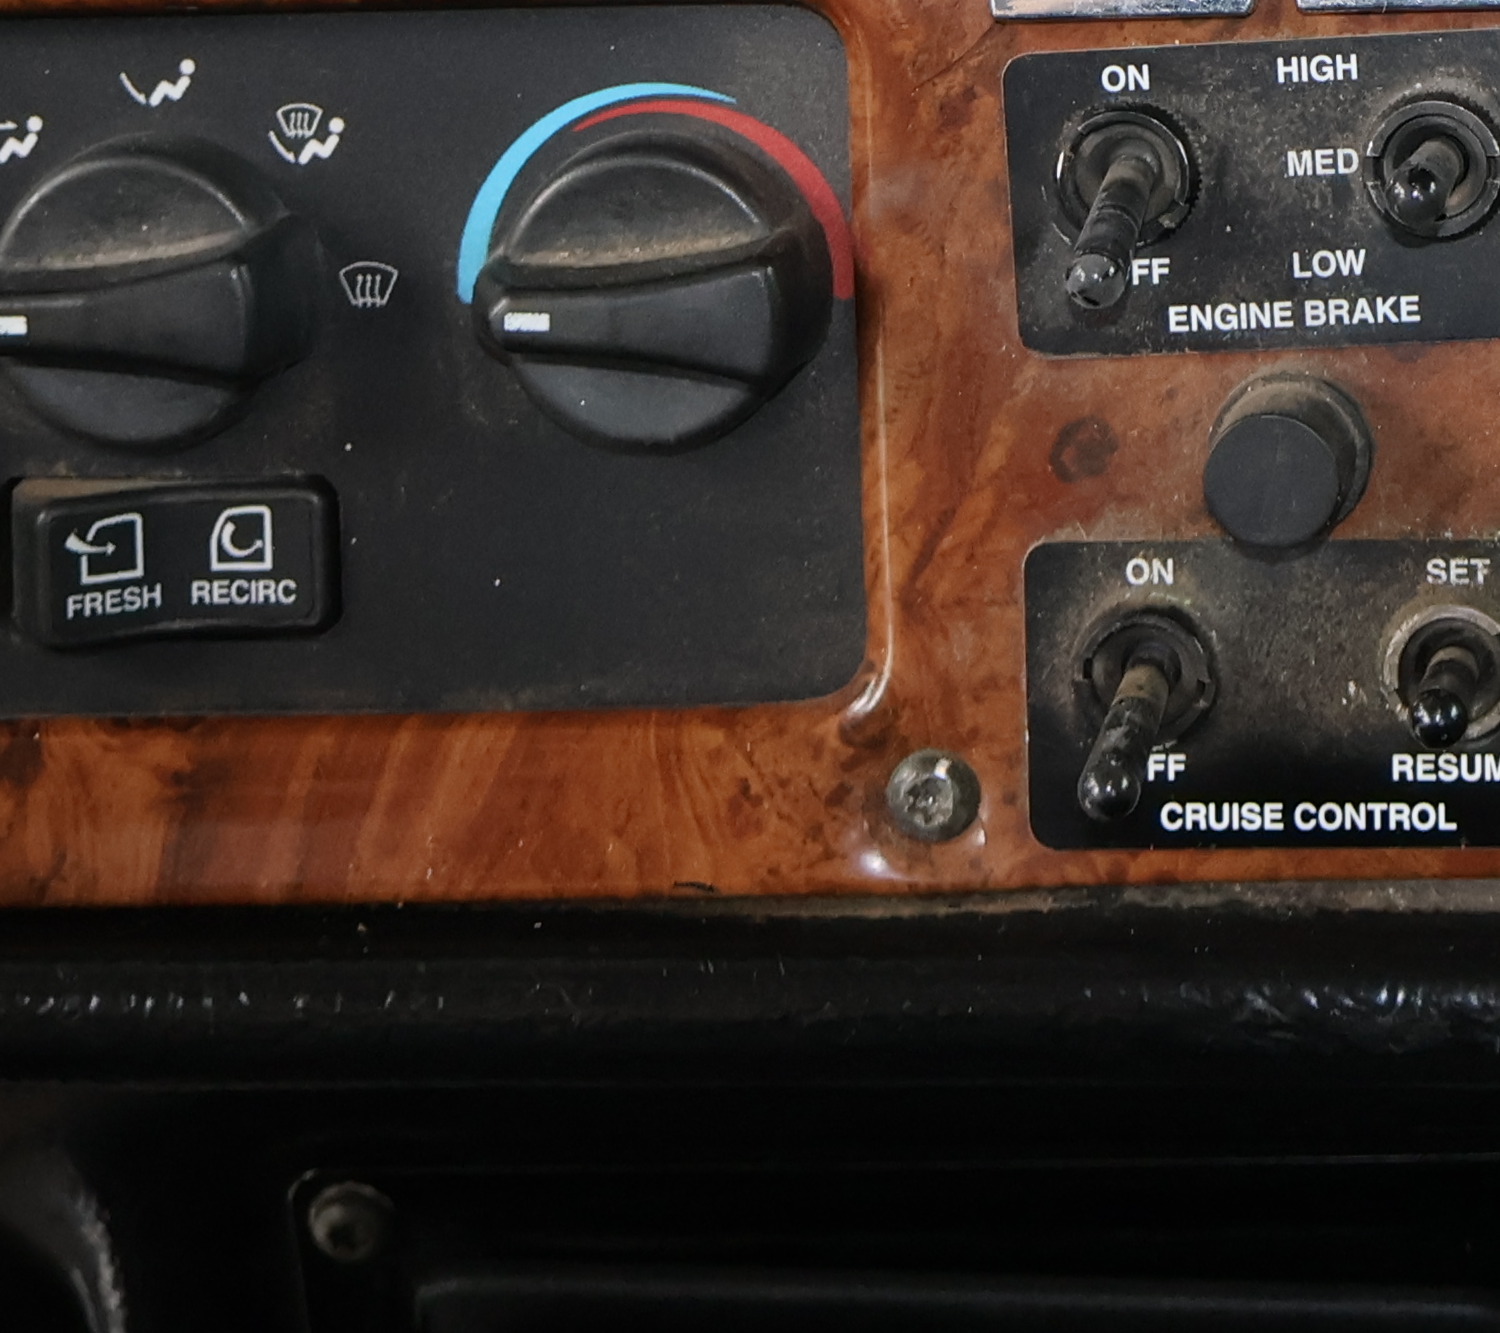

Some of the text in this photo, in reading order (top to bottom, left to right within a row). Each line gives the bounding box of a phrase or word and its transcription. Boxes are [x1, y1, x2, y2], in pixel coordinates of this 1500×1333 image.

[1101, 65, 1150, 93] ON
[1277, 55, 1358, 85] HIGH
[1287, 149, 1359, 177] MED
[1132, 258, 1170, 286] FF
[1293, 249, 1366, 279] LOW
[1168, 296, 1421, 334] ENGINE BRAKE
[1125, 558, 1174, 586] ON
[1426, 559, 1490, 585] SET
[67, 585, 163, 621] FRESH
[191, 577, 298, 608] RECIRC
[1147, 753, 1187, 781] FF
[1160, 803, 1457, 831] CRUISE CONTROL
